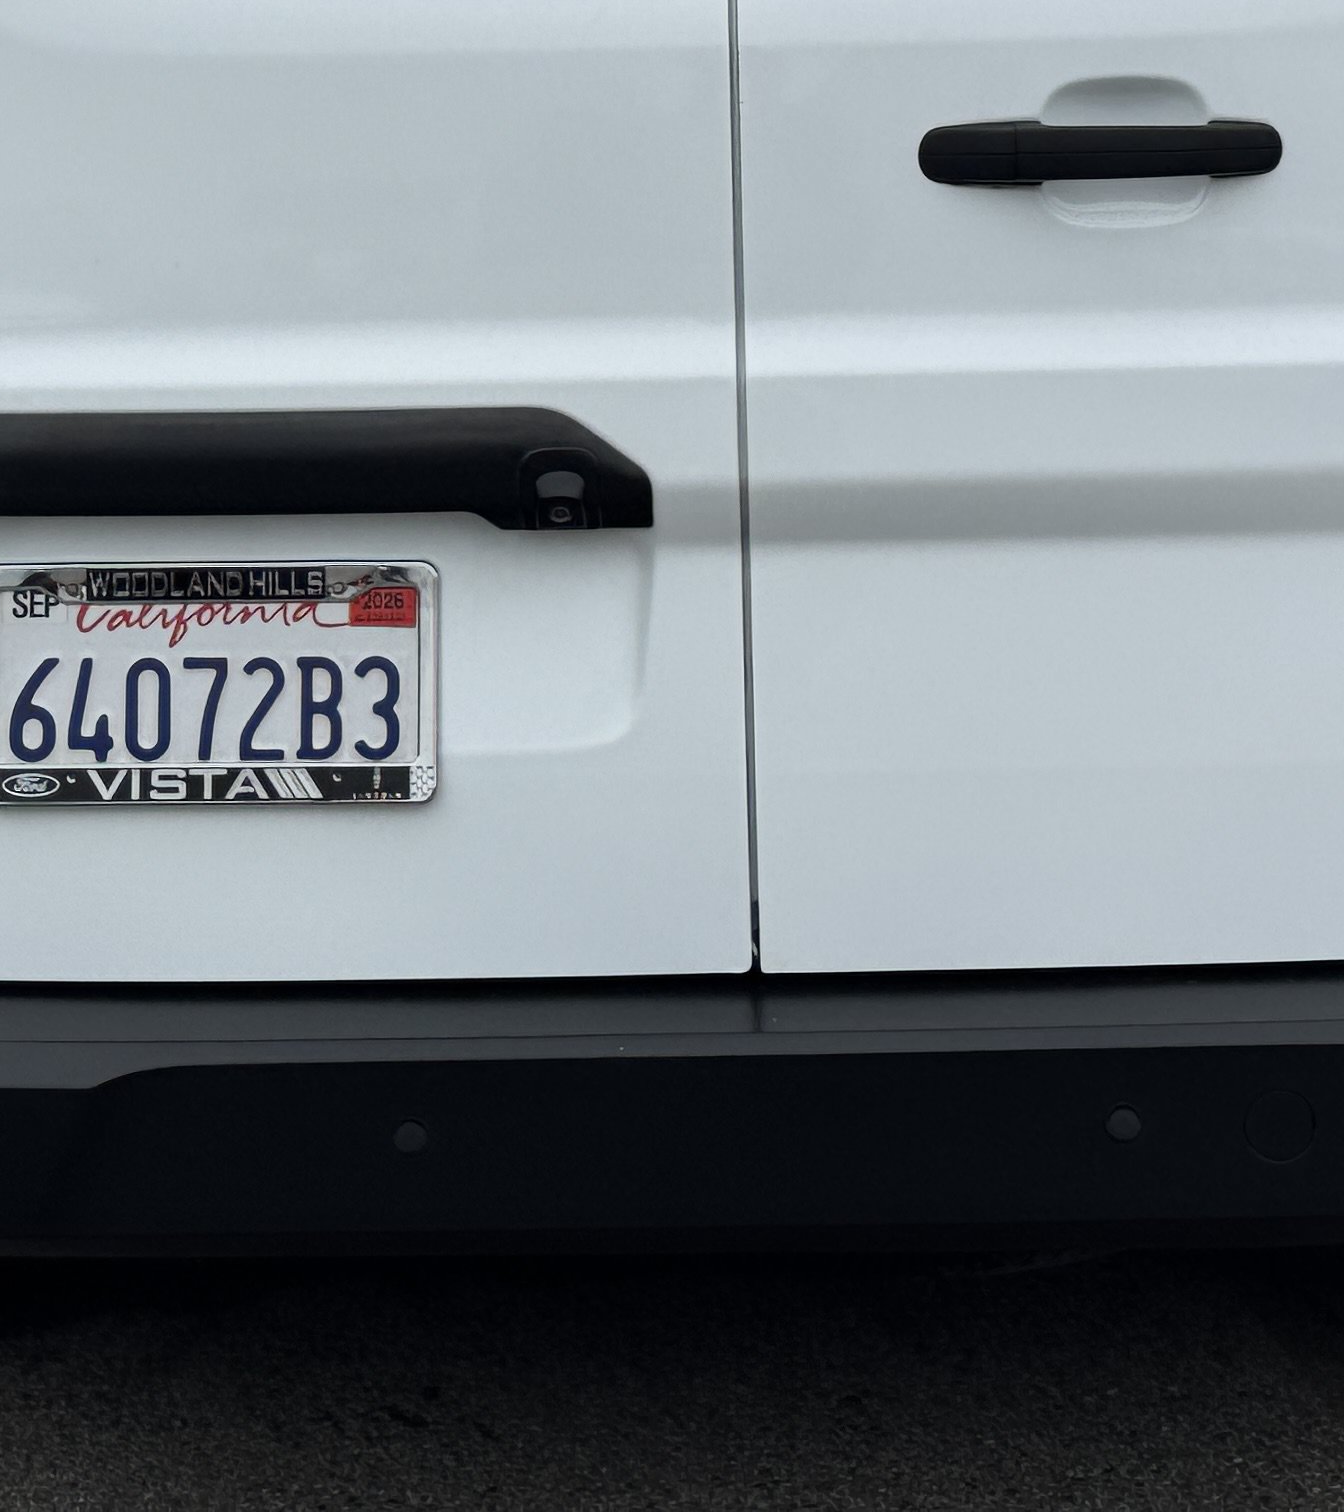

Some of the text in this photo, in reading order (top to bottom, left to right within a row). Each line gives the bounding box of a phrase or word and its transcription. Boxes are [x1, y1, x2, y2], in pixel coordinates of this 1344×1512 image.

[87, 570, 325, 599] WOODLAND HILLS
[12, 590, 60, 619] SEP
[362, 591, 405, 610] 2026
[76, 602, 349, 649] California
[8, 655, 402, 763] 64072B3
[86, 767, 273, 801] VISTA
